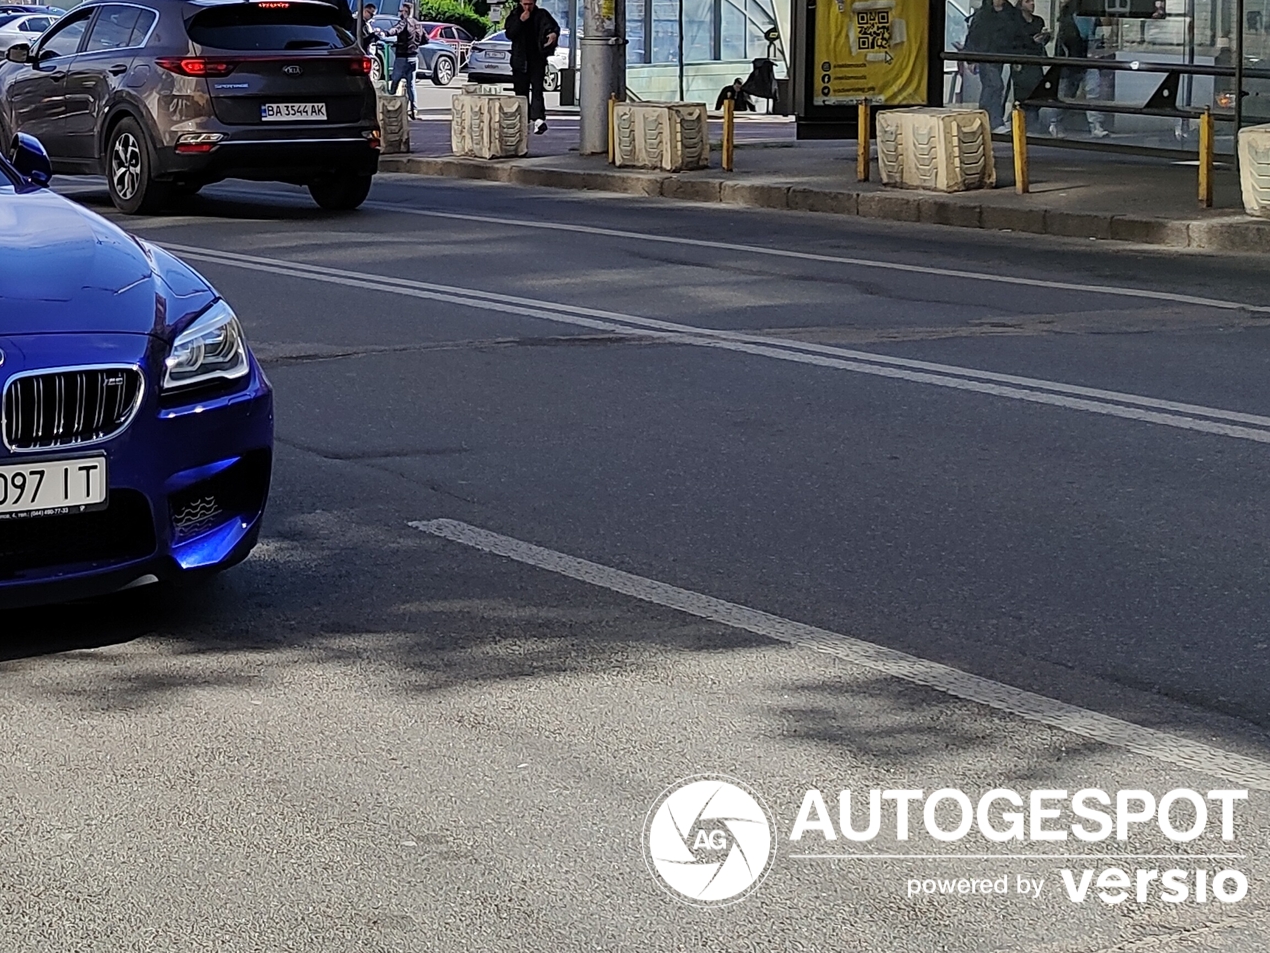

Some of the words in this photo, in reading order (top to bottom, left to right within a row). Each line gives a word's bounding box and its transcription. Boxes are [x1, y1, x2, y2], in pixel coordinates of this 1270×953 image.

[289, 66, 301, 74] KIA
[266, 105, 283, 117] BA
[285, 105, 308, 117] 3544
[310, 104, 325, 116] AK
